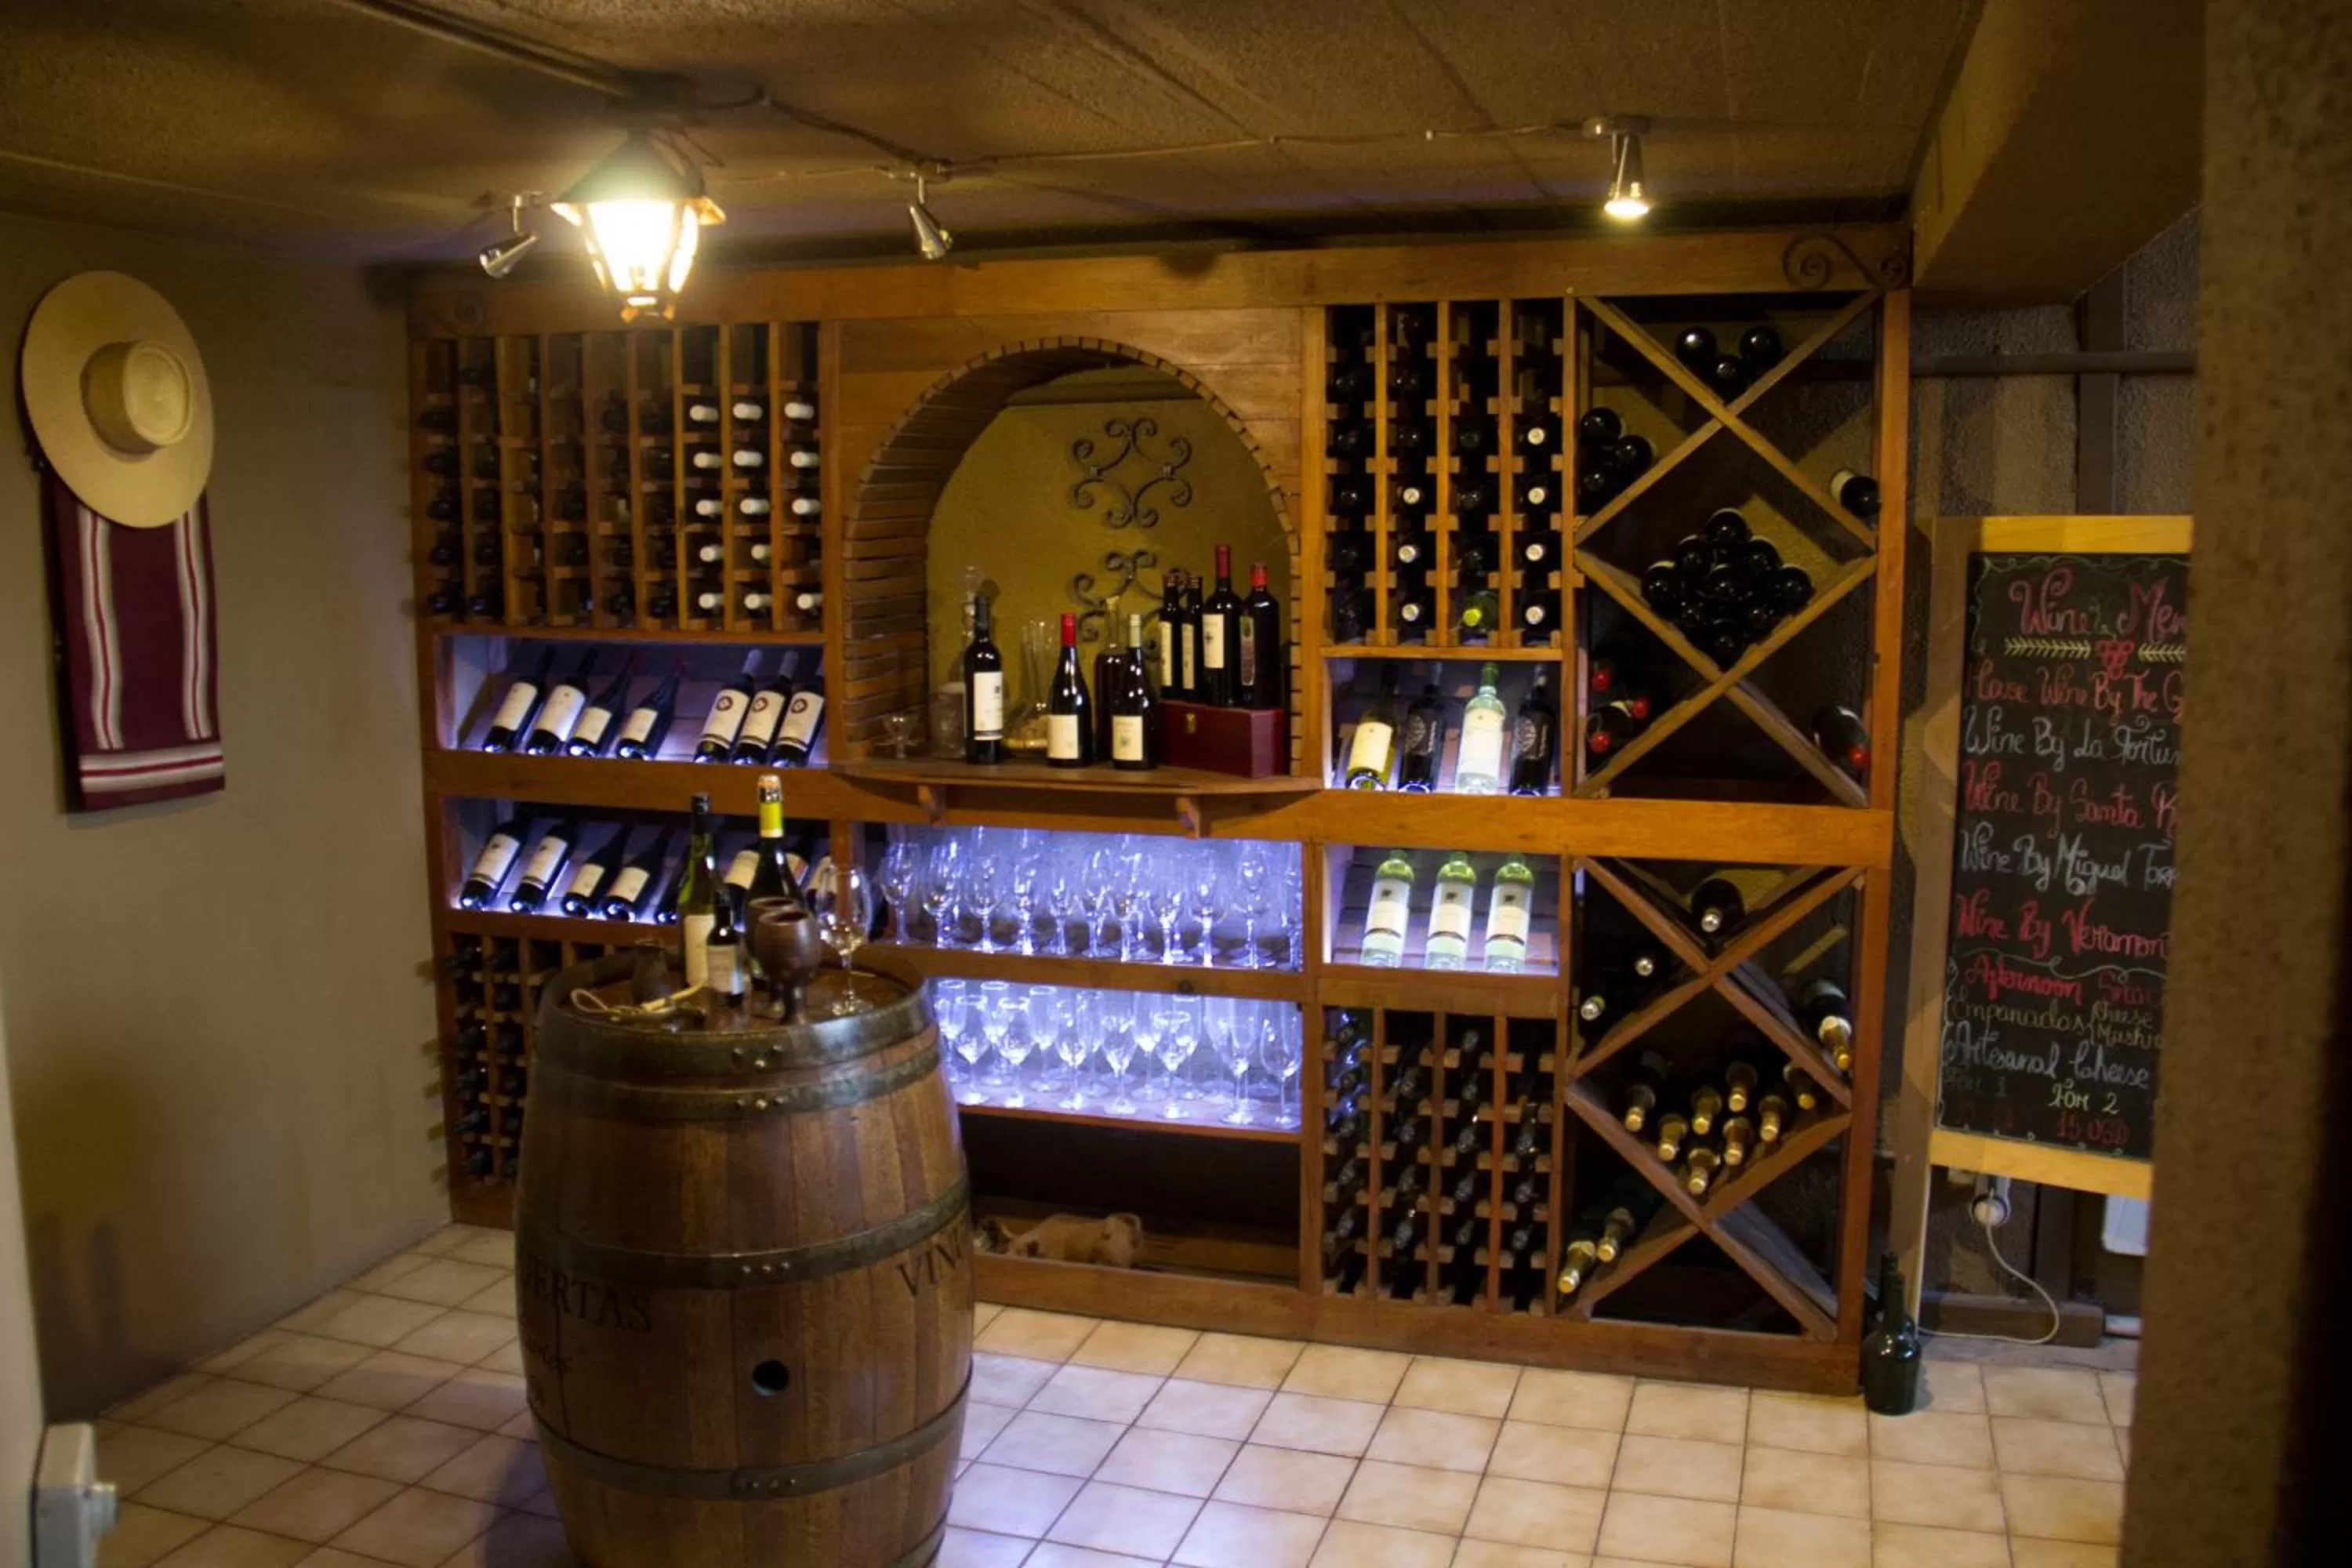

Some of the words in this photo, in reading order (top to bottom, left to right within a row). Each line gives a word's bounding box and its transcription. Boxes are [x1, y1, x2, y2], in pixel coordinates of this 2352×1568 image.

[2008, 566, 2091, 636] Wine
[2089, 671, 2122, 728] By
[2122, 667, 2158, 713] The
[1962, 705, 2025, 755] Wine
[2031, 716, 2065, 772] By
[1962, 758, 2024, 813] Wine
[2025, 771, 2063, 840] By
[1958, 820, 2013, 873] Wine
[2011, 833, 2051, 893] By
[2052, 833, 2132, 896] Miguel
[1956, 888, 2010, 940] Wine
[2019, 899, 2053, 960] By
[2101, 1091, 2122, 1116] 2
